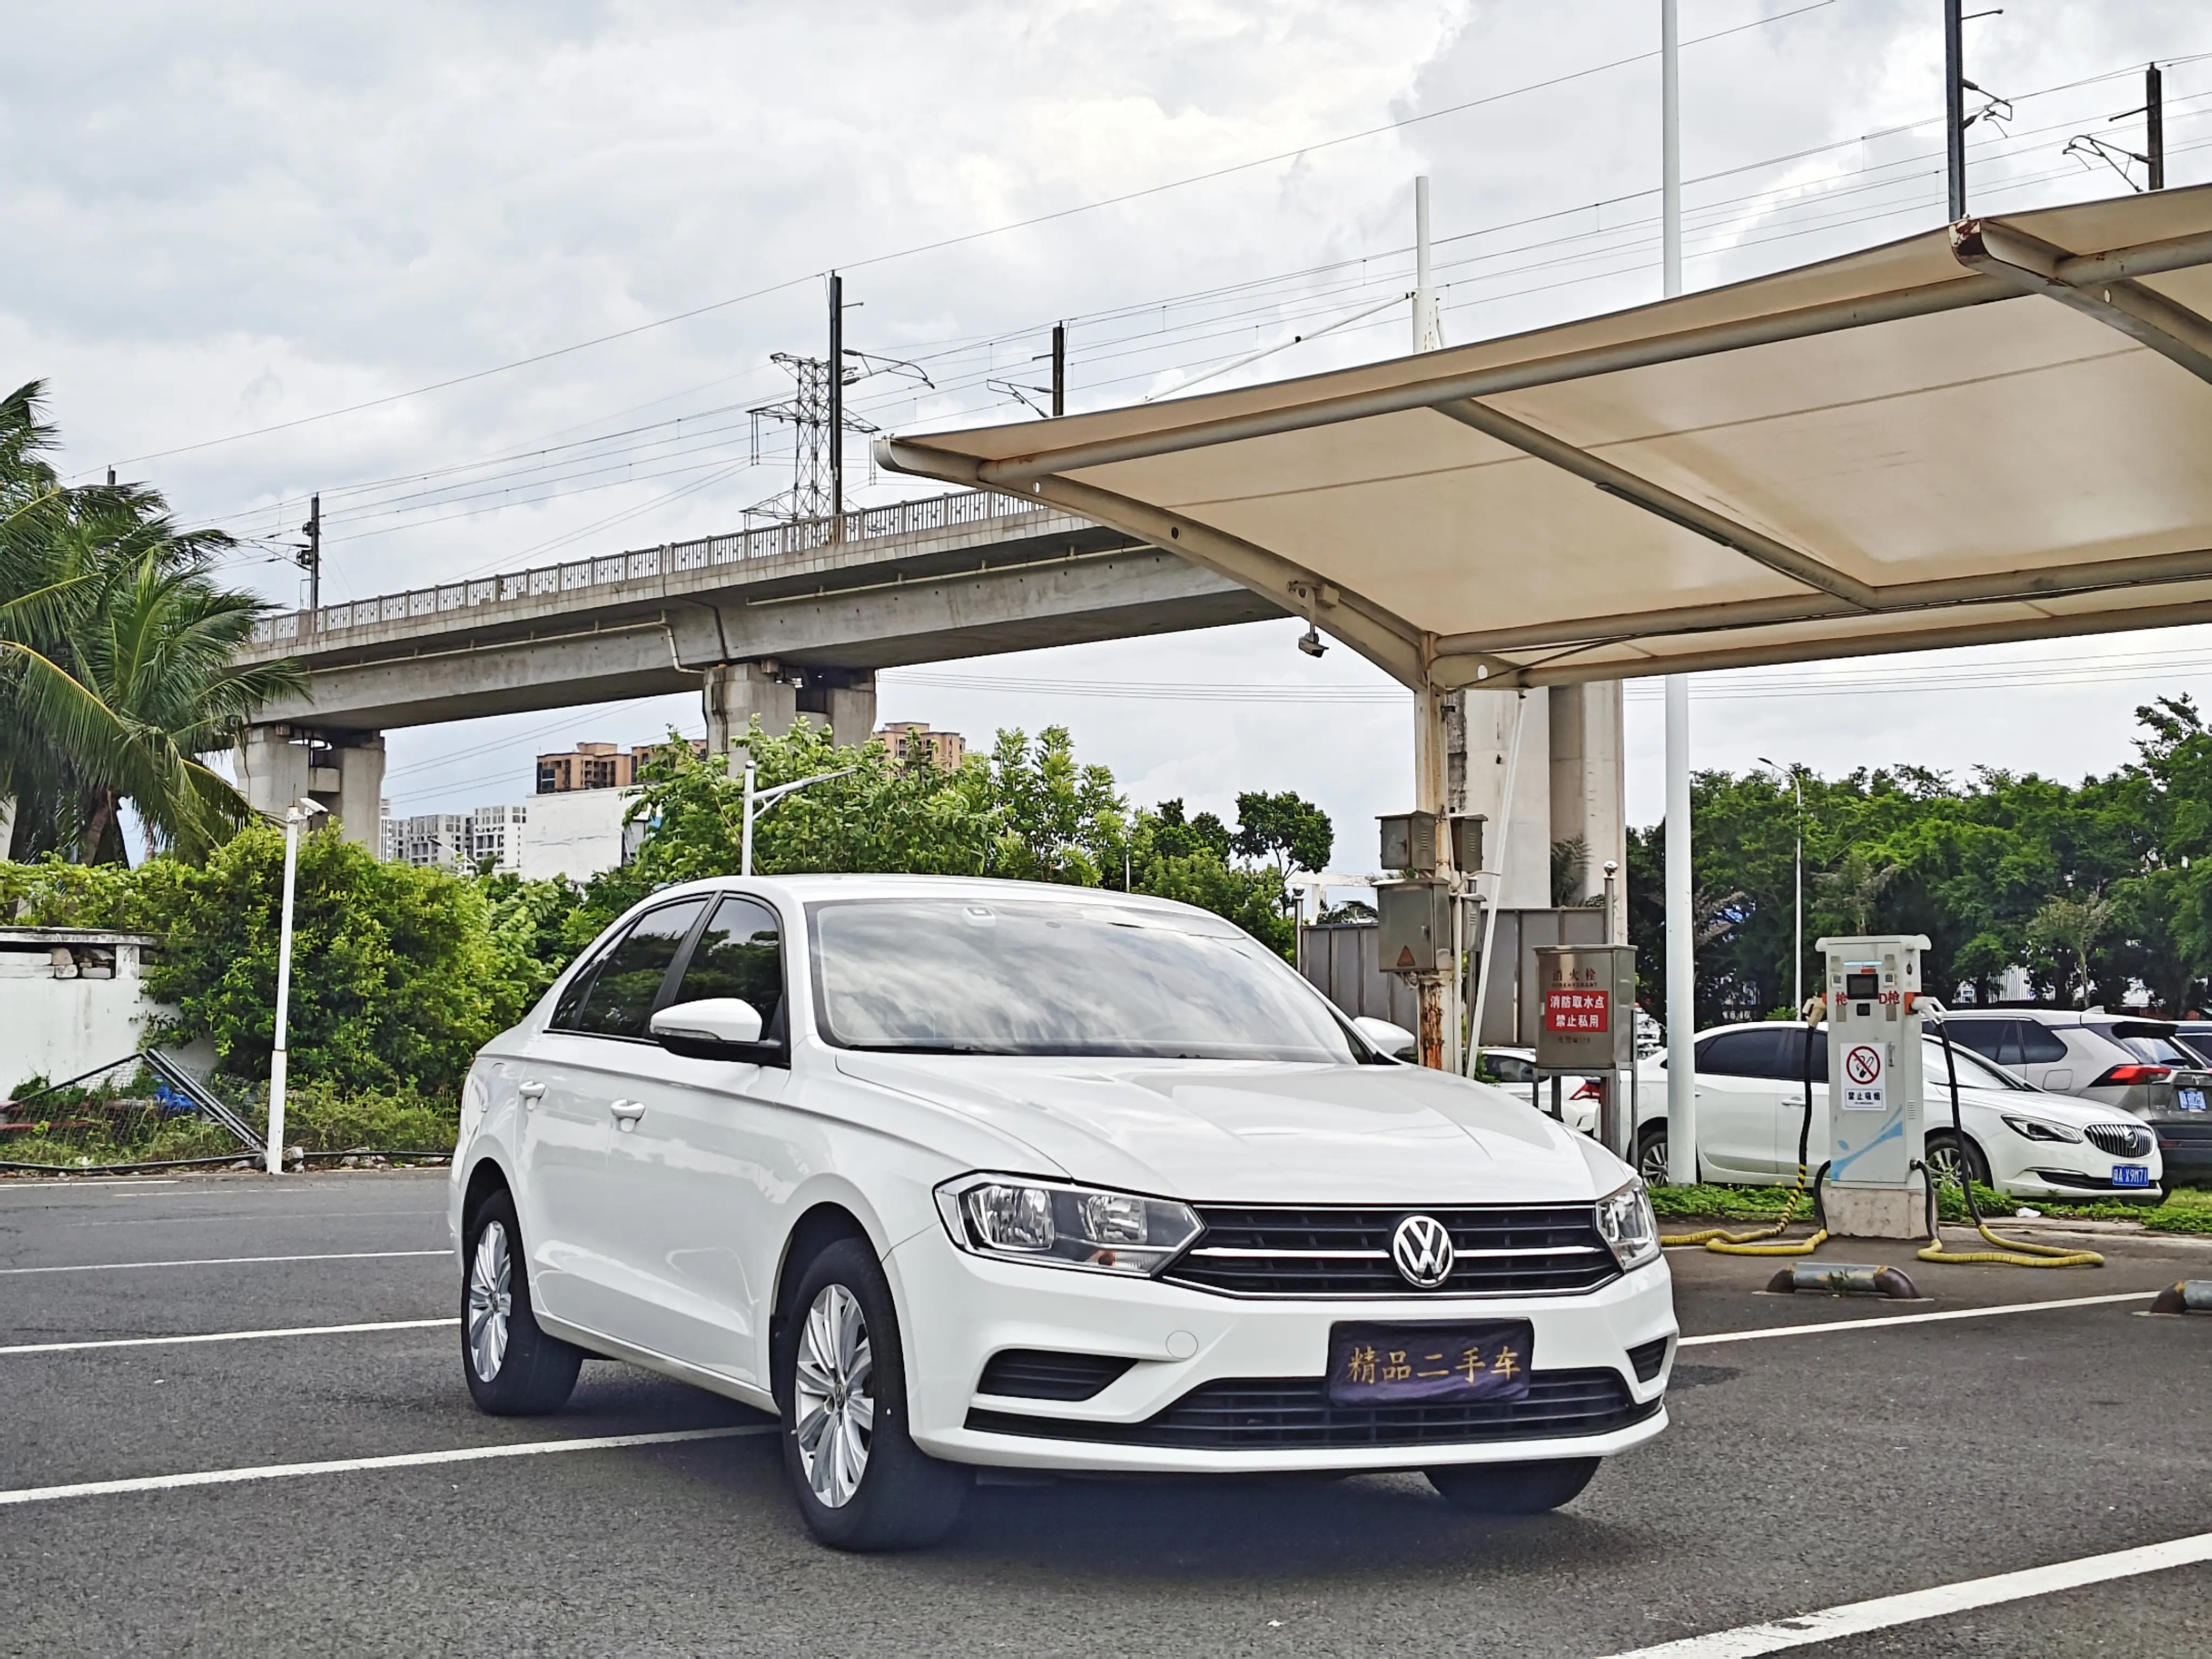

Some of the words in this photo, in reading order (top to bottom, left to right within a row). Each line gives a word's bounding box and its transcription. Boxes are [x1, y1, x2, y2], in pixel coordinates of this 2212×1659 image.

[1550, 995, 1604, 1009] 消防取水点
[1556, 1015, 1599, 1028] 禁止私用
[1346, 1345, 1521, 1385] 精品二手车
